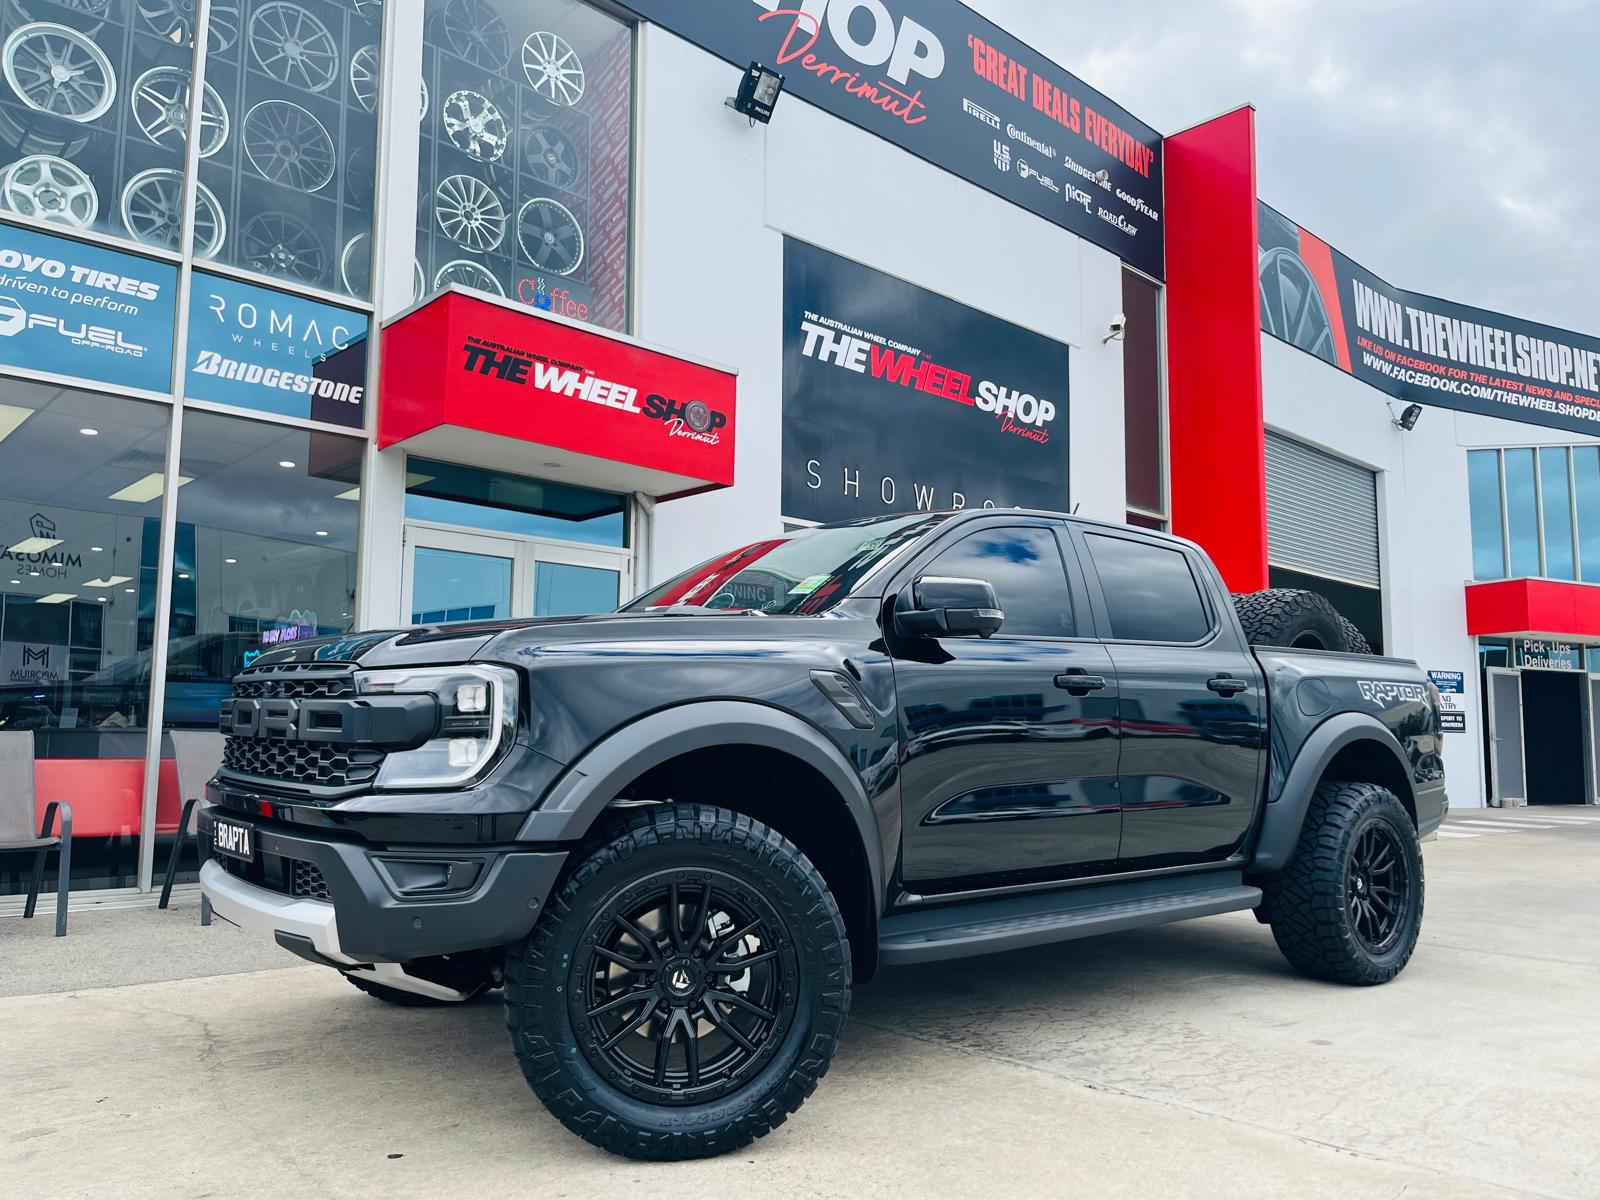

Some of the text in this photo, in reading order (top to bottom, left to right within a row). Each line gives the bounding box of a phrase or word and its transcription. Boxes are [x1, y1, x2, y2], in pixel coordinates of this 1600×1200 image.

[758, 9, 928, 125] Derrimut
[962, 97, 1001, 130] PIRELLI
[1032, 72, 1081, 135] DEALS
[1006, 123, 1053, 159] Continental
[1064, 155, 1112, 192] BRIDGESNE
[1115, 188, 1159, 221] GOODYEAR
[0, 249, 160, 301] OYO TIRES
[51, 286, 68, 299] to
[69, 292, 139, 316] perform
[28, 313, 144, 350] FUEL
[209, 294, 349, 350] ROMAC
[804, 310, 820, 322] THE
[819, 315, 864, 338] AUSTRALIAN
[863, 330, 887, 346] WHEEL
[887, 338, 921, 356] COMPANY
[71, 338, 143, 358] OFF-ROAD
[231, 333, 327, 362] WHEELS
[467, 335, 482, 345] THE
[481, 338, 527, 358] AUSTRALIAN
[526, 351, 550, 364] WHEEL
[550, 358, 586, 373] COMPANY
[192, 350, 364, 405] BRIDGESTONE
[1356, 335, 1373, 351] LIKE
[1372, 343, 1384, 357] US
[1384, 348, 1397, 363] ON
[1396, 354, 1448, 377] FACEBOOK
[1447, 367, 1468, 381] FOR
[1469, 371, 1489, 385] THE
[1488, 376, 1525, 392] LATEST
[1525, 384, 1553, 398] NEWS
[1553, 390, 1574, 402] AND
[642, 393, 727, 433] SHP
[975, 380, 1056, 427] SHOP
[664, 418, 720, 446] Derrimut
[995, 410, 1050, 444] Derrimut
[806, 459, 1021, 511] SHOWR
[1523, 639, 1545, 653] Pick
[1552, 640, 1571, 657] Ups
[1524, 654, 1572, 669] Deliveries
[1431, 671, 1461, 680] WARNING
[1356, 680, 1432, 712] RAPTOR
[1440, 702, 1457, 710] NTRY
[218, 822, 250, 856] BRAPTA
